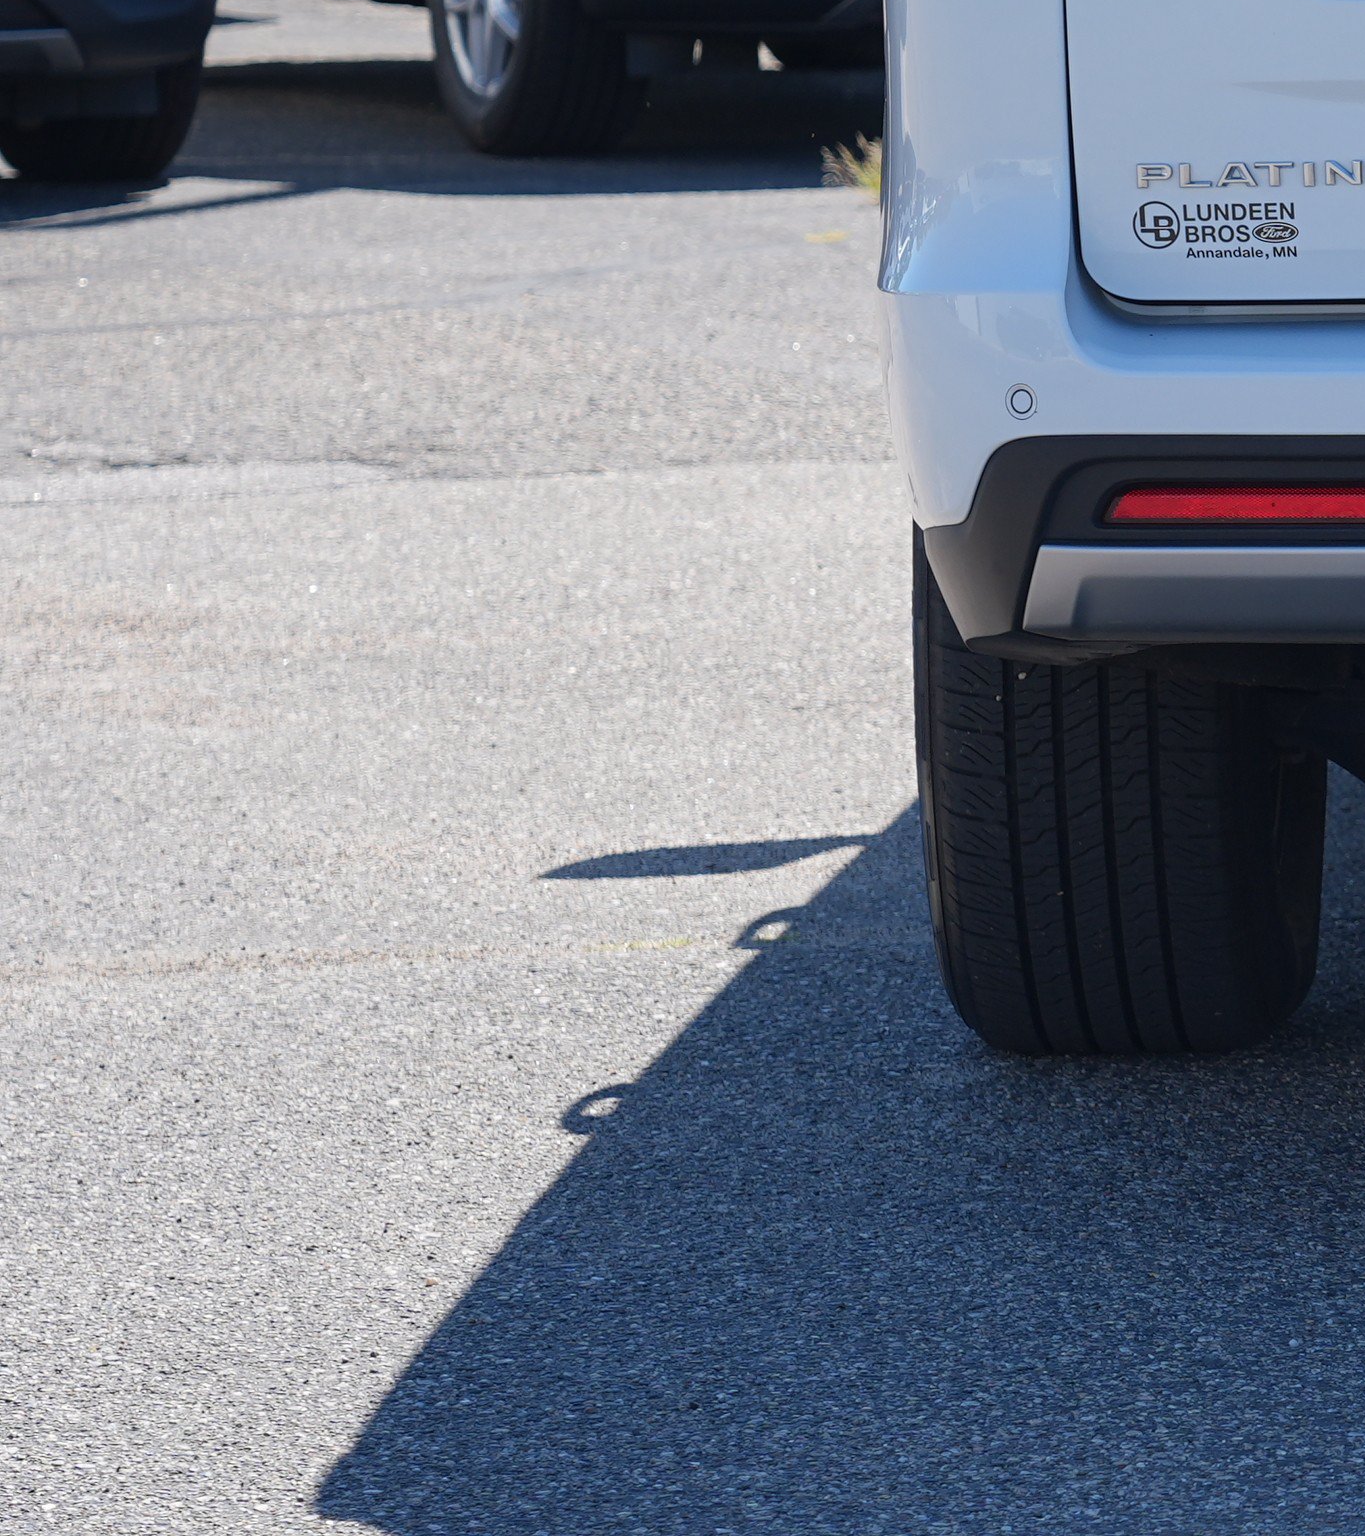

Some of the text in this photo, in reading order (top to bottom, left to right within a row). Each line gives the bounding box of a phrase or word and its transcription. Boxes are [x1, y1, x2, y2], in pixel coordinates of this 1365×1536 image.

[1182, 202, 1296, 222] LUNDEEN
[1184, 224, 1251, 243] BROS
[1259, 225, 1293, 240] Ford
[1186, 246, 1298, 260] Annandale, MN
